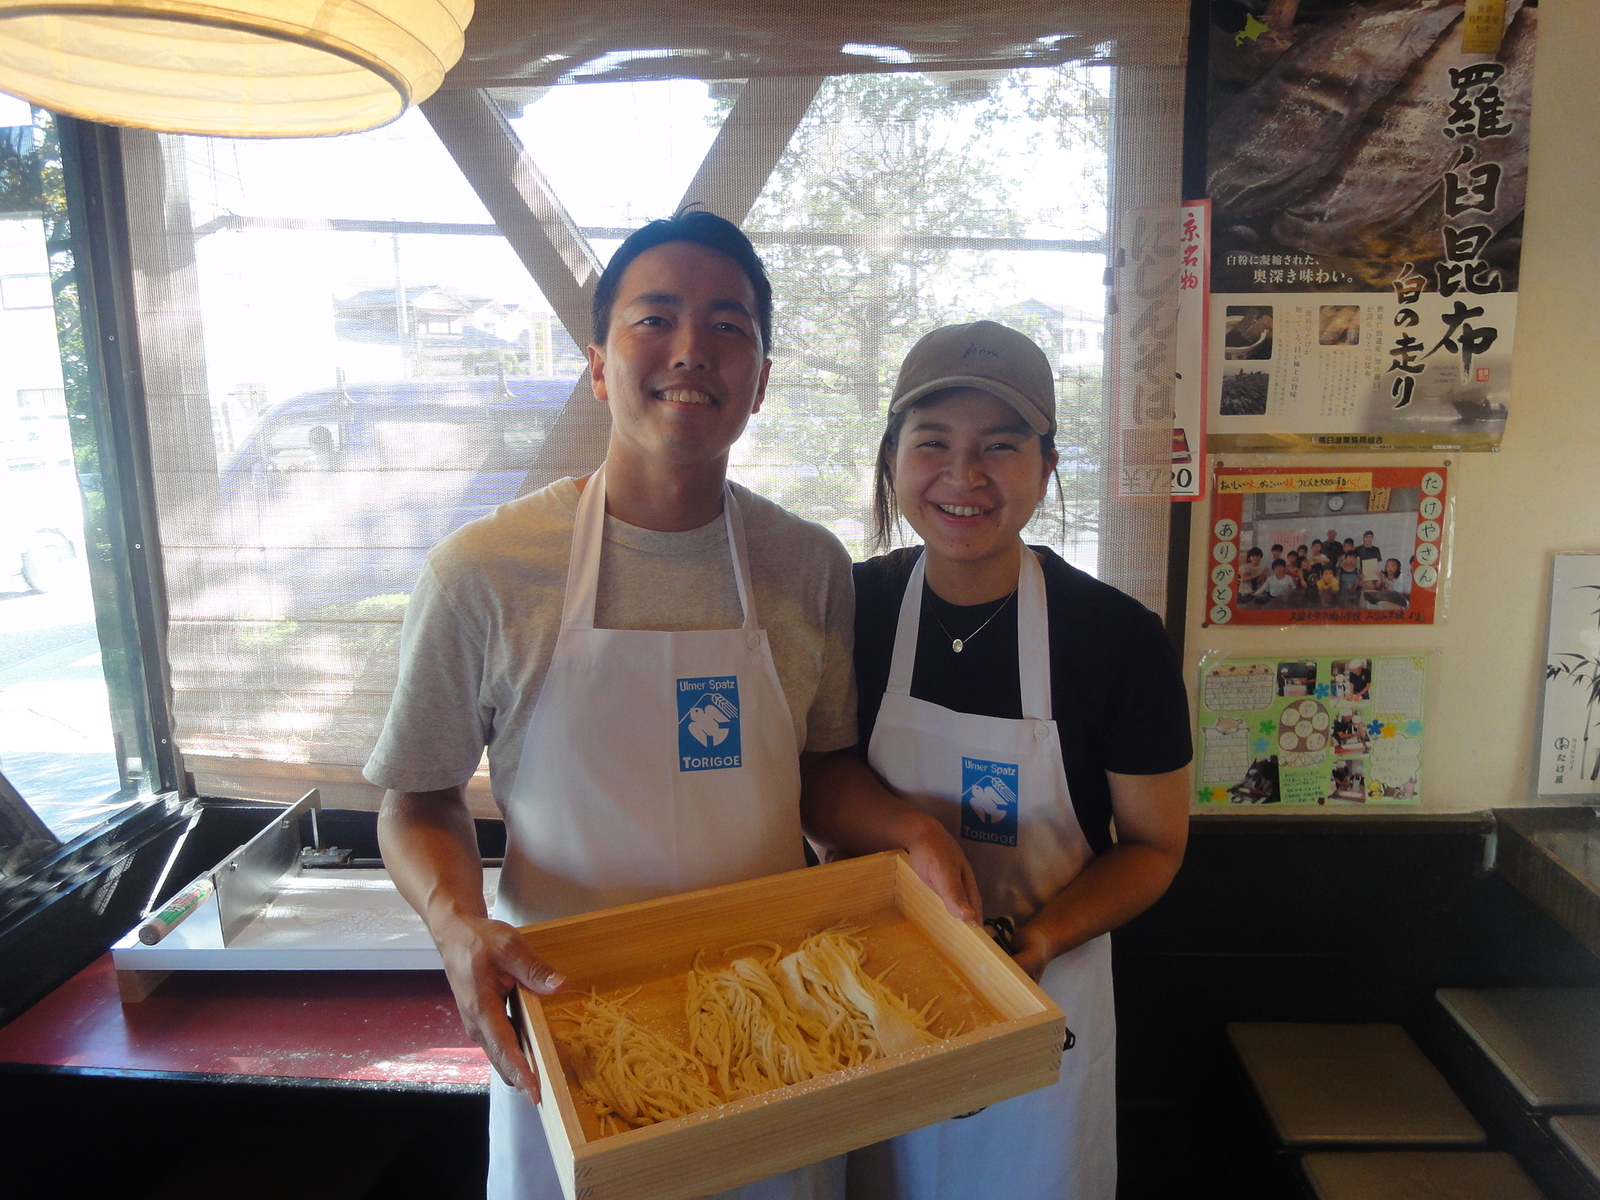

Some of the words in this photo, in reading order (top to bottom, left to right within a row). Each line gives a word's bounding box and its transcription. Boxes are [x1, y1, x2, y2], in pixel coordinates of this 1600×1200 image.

[1253, 269, 1353, 284] 奥深き味わい。
[1419, 477, 1438, 582] たけやさん
[1216, 523, 1233, 620] ありがとう
[679, 680, 706, 692] Ulmer
[709, 679, 735, 692] Spatz
[683, 755, 740, 769] TORIGOE
[964, 759, 988, 774] Ulmer
[990, 762, 1016, 777] Spatz
[963, 826, 1016, 846] TORIGOE
